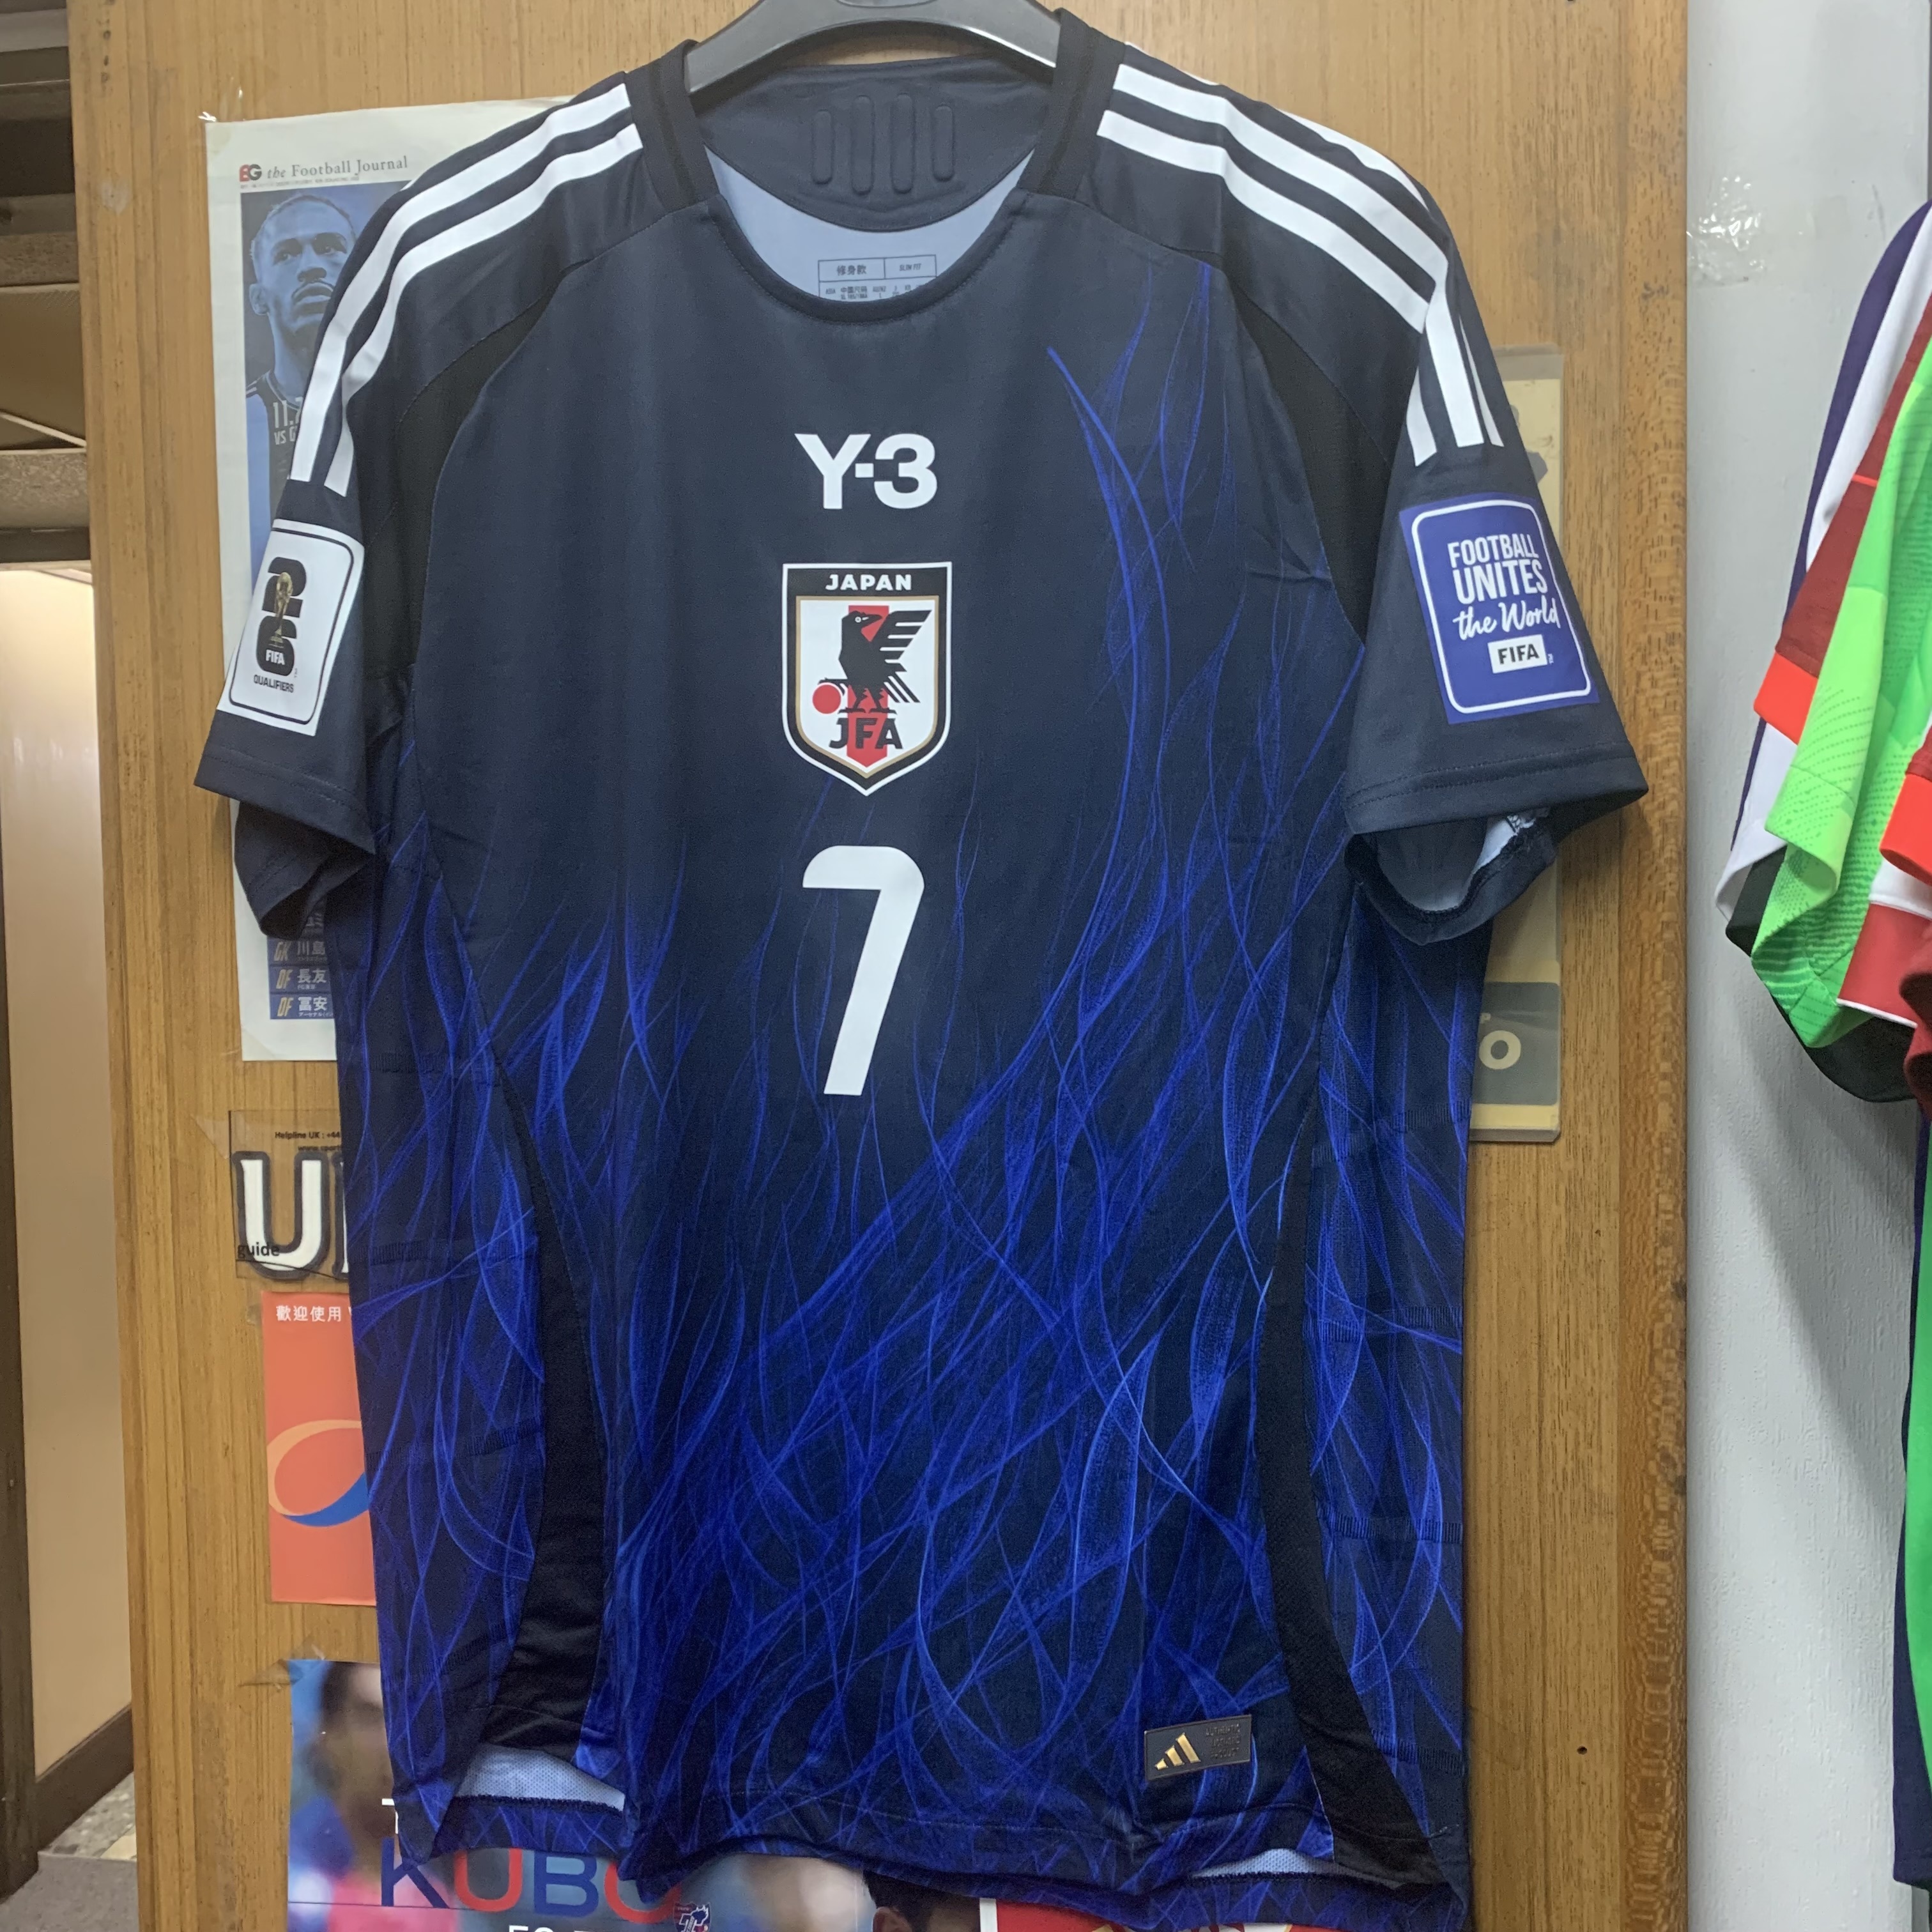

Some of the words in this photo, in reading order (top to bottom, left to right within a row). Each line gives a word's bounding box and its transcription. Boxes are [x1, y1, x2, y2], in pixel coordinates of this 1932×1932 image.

[267, 166, 286, 178] the
[291, 160, 351, 177] Football
[355, 155, 408, 176] Journal
[273, 430, 286, 445] VS
[794, 433, 937, 509] Y-3
[1447, 533, 1539, 568] FOOTBALL
[825, 574, 912, 591] JAPAN
[1452, 559, 1548, 604] UNITES
[1452, 606, 1497, 641] the
[1498, 595, 1561, 633] World
[266, 649, 286, 665] FIFA
[1497, 643, 1540, 665] FIFA
[253, 675, 294, 693] QUALIFIERS
[829, 717, 903, 749] JFA
[297, 968, 327, 983] 長友
[802, 845, 924, 1096] 7
[275, 1131, 307, 1140] Helpline
[237, 1242, 280, 1259] guide
[275, 1305, 342, 1322] 歡迎使用
